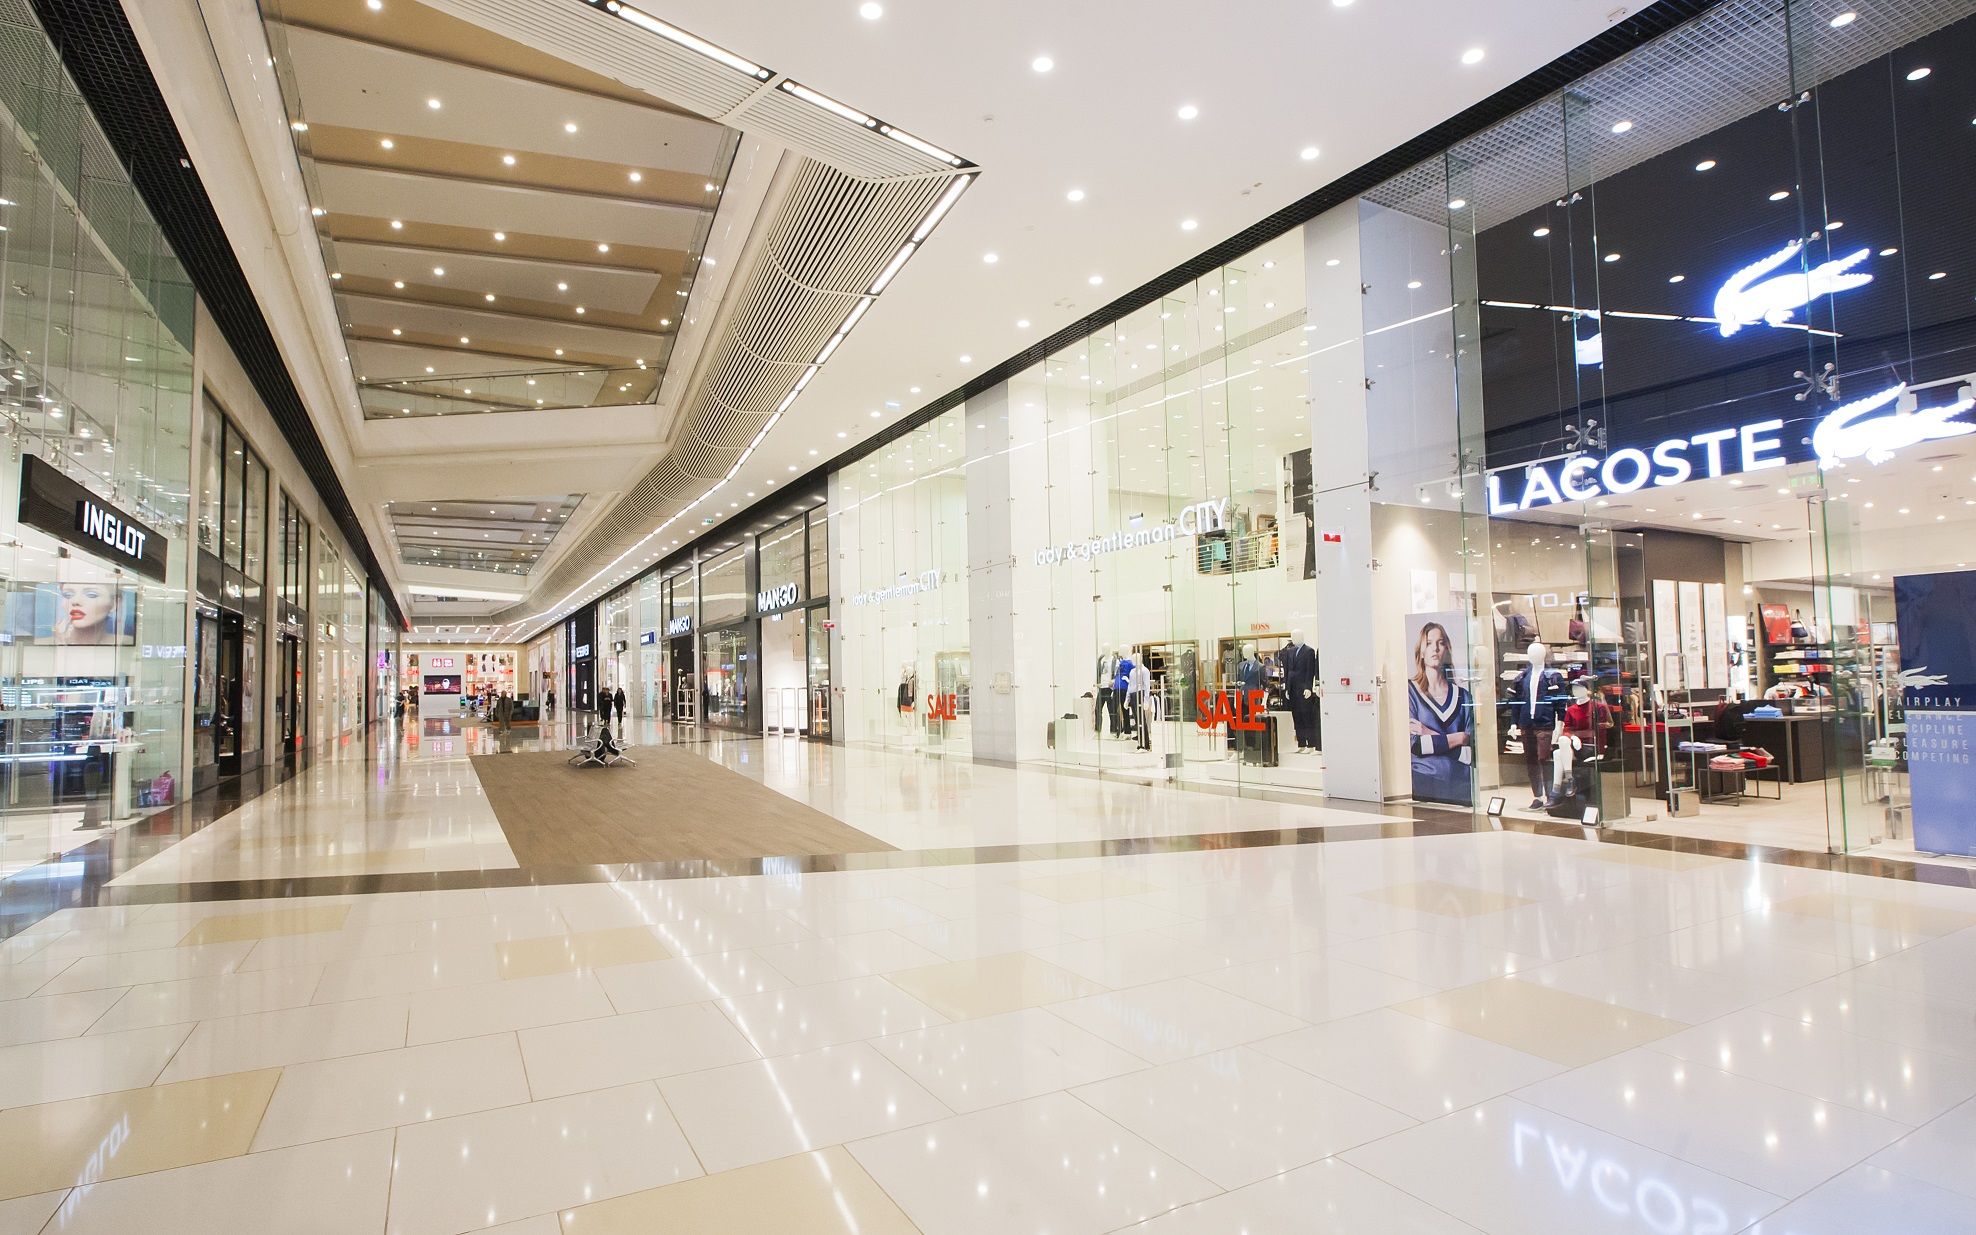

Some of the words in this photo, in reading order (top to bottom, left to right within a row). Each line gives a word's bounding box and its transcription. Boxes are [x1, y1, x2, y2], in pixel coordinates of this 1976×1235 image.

[1489, 418, 1787, 515] LACOSTE
[83, 501, 146, 560] INGLOT
[1034, 547, 1063, 566] lady
[1067, 541, 1078, 560] &
[1081, 523, 1175, 562] gentleman
[1179, 497, 1229, 536] CITY
[757, 582, 798, 612] MANGO
[669, 615, 690, 635] MANGO
[1250, 623, 1270, 631] BOSS
[928, 694, 957, 720] SALE
[1196, 688, 1266, 731] SALE
[1888, 697, 1961, 707] FAIRPLAY
[1895, 752, 1969, 764] COMPETING
